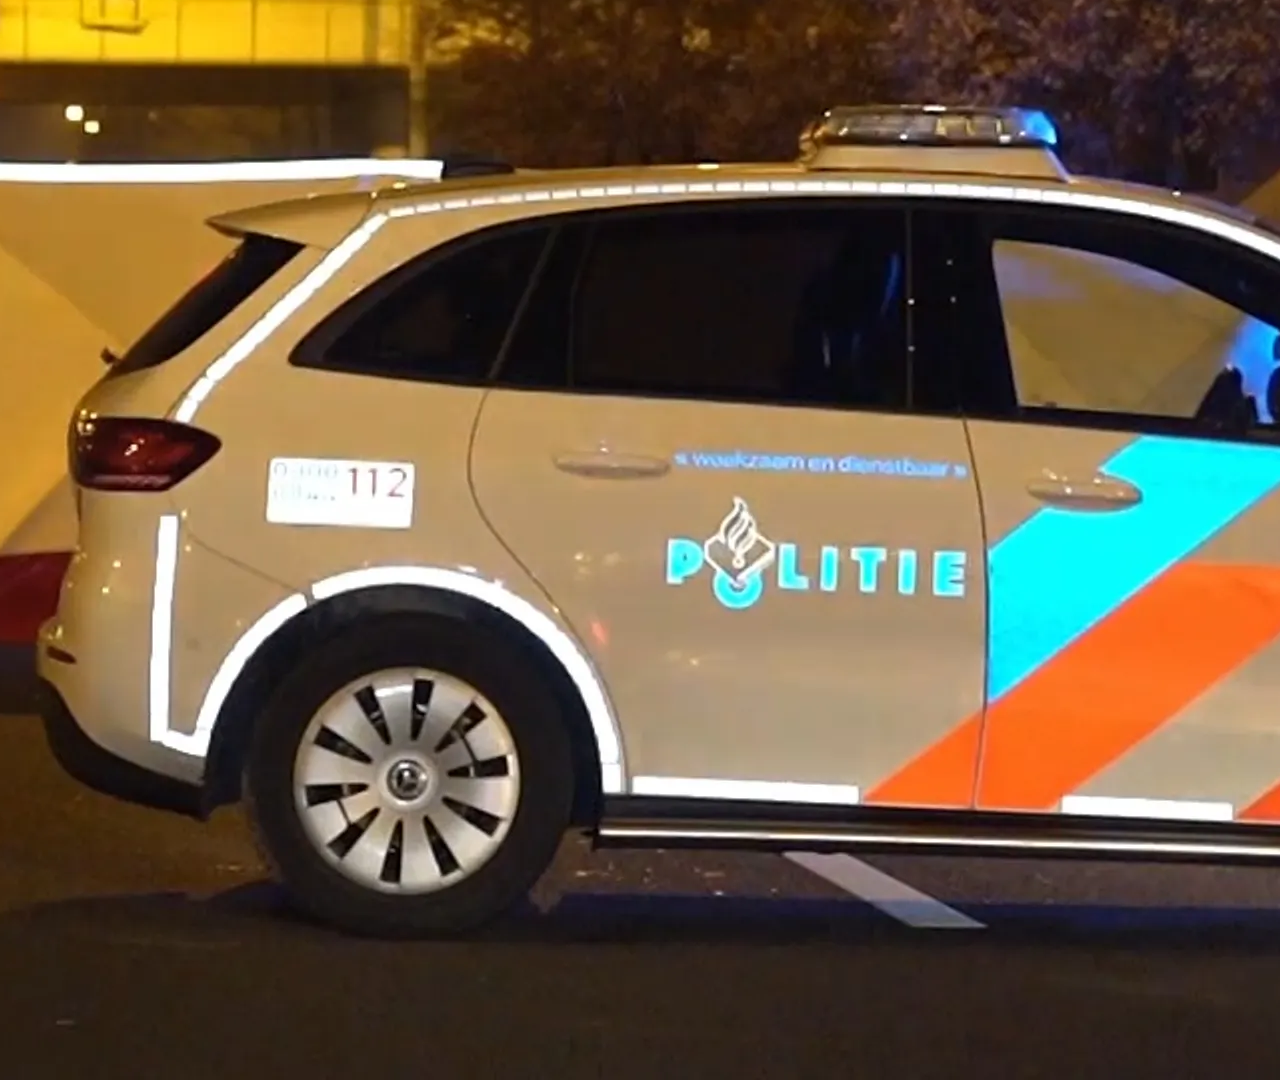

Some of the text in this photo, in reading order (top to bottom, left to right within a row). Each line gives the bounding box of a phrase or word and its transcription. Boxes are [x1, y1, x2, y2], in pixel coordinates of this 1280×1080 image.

[347, 467, 407, 498] 112
[807, 456, 835, 473] en
[838, 456, 949, 478] dienstbaar
[666, 537, 967, 609] POLITIE
